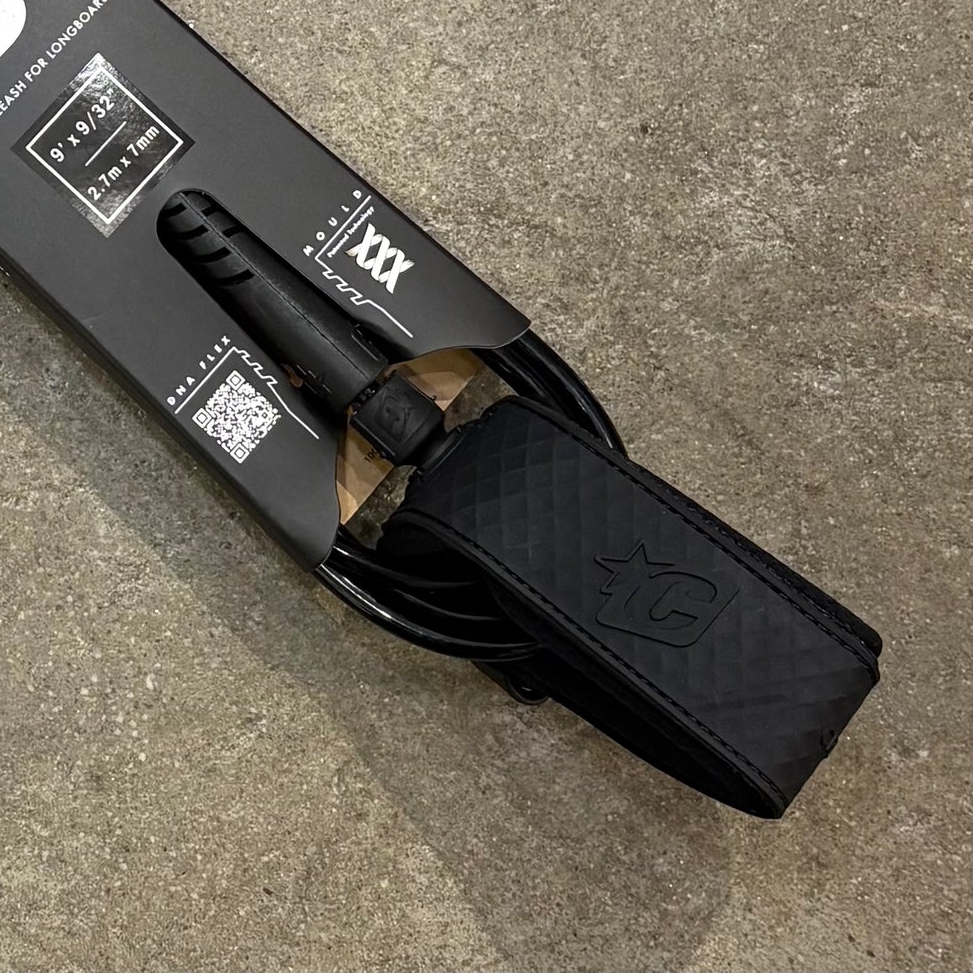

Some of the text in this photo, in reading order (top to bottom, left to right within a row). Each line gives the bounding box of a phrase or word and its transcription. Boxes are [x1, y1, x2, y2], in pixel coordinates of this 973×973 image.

[24, 57, 49, 83] FOR
[66, 133, 81, 147] x
[87, 125, 161, 201] 2.7m x 7mm
[302, 190, 362, 257] MOULD
[167, 335, 230, 406] DNA FLEX
